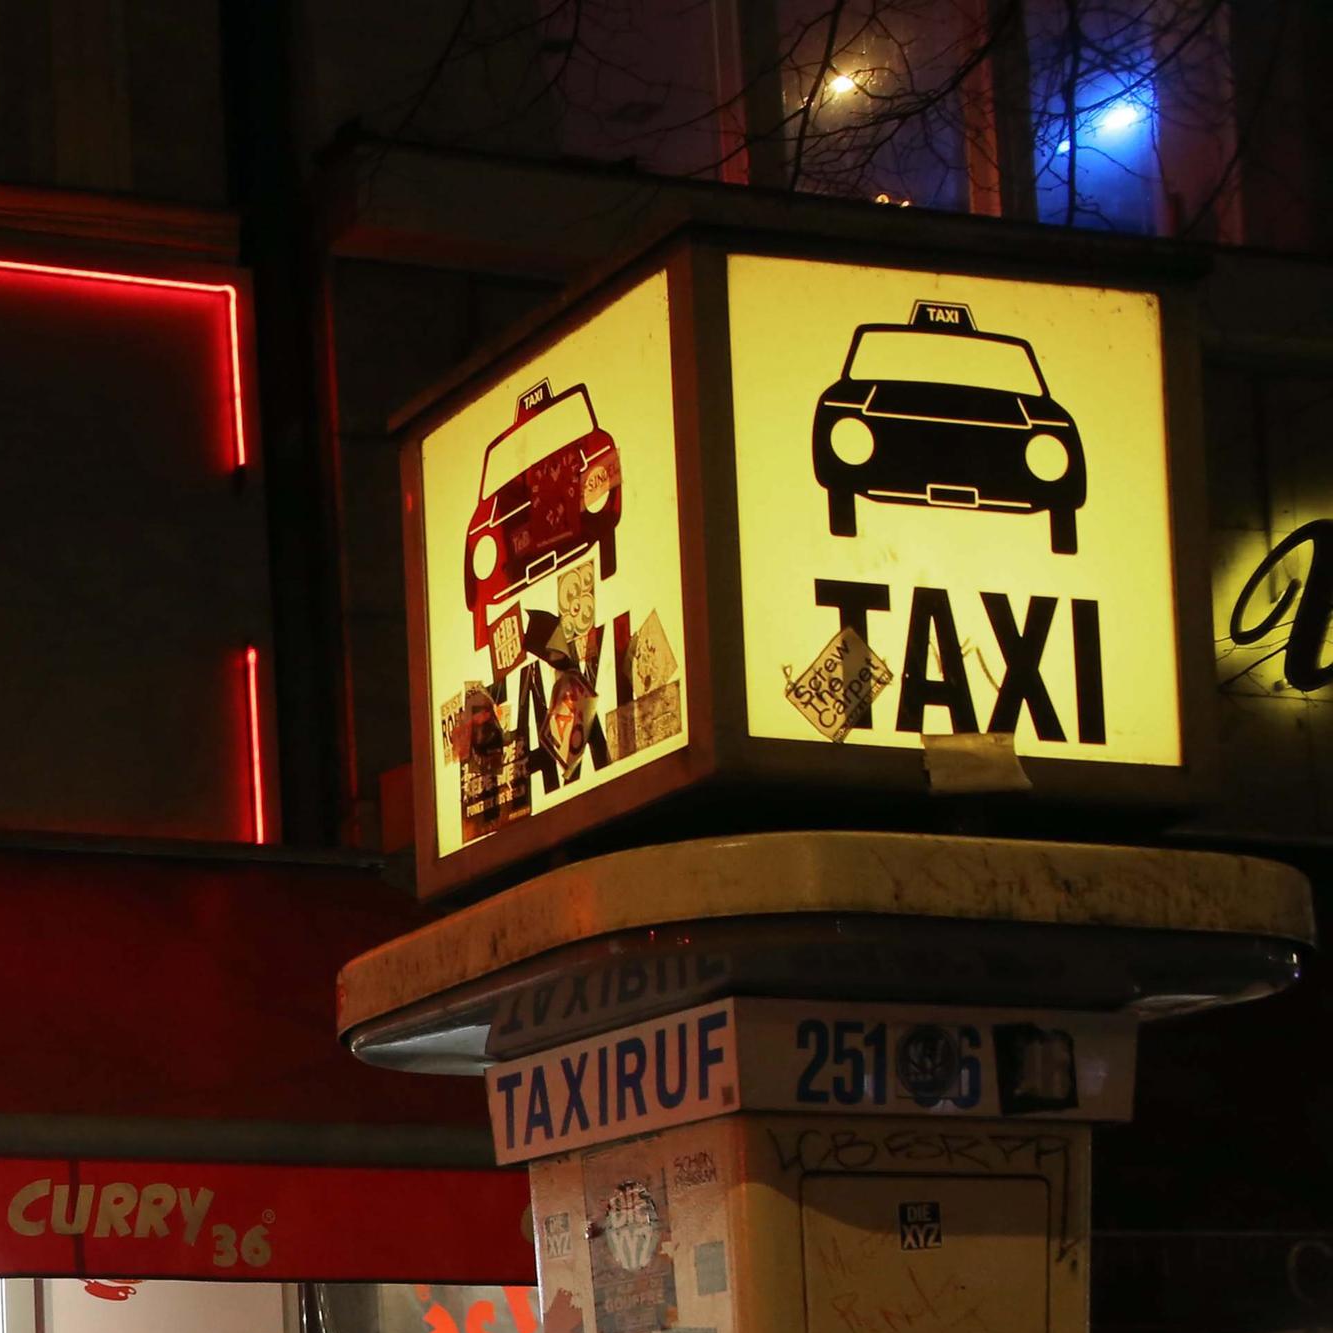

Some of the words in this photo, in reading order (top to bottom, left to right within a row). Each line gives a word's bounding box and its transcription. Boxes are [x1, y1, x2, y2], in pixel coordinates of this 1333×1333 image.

[927, 307, 961, 325] TAXI
[524, 389, 544, 411] TAXI
[793, 638, 852, 706] Screw
[814, 578, 1107, 746] TAXI
[805, 675, 844, 720] The
[818, 655, 881, 729] Carpet
[496, 1010, 729, 1150] TAXIRUF
[7, 1177, 215, 1247] CURRY
[903, 1224, 941, 1249] XYZ
[907, 1207, 931, 1222] DIE
